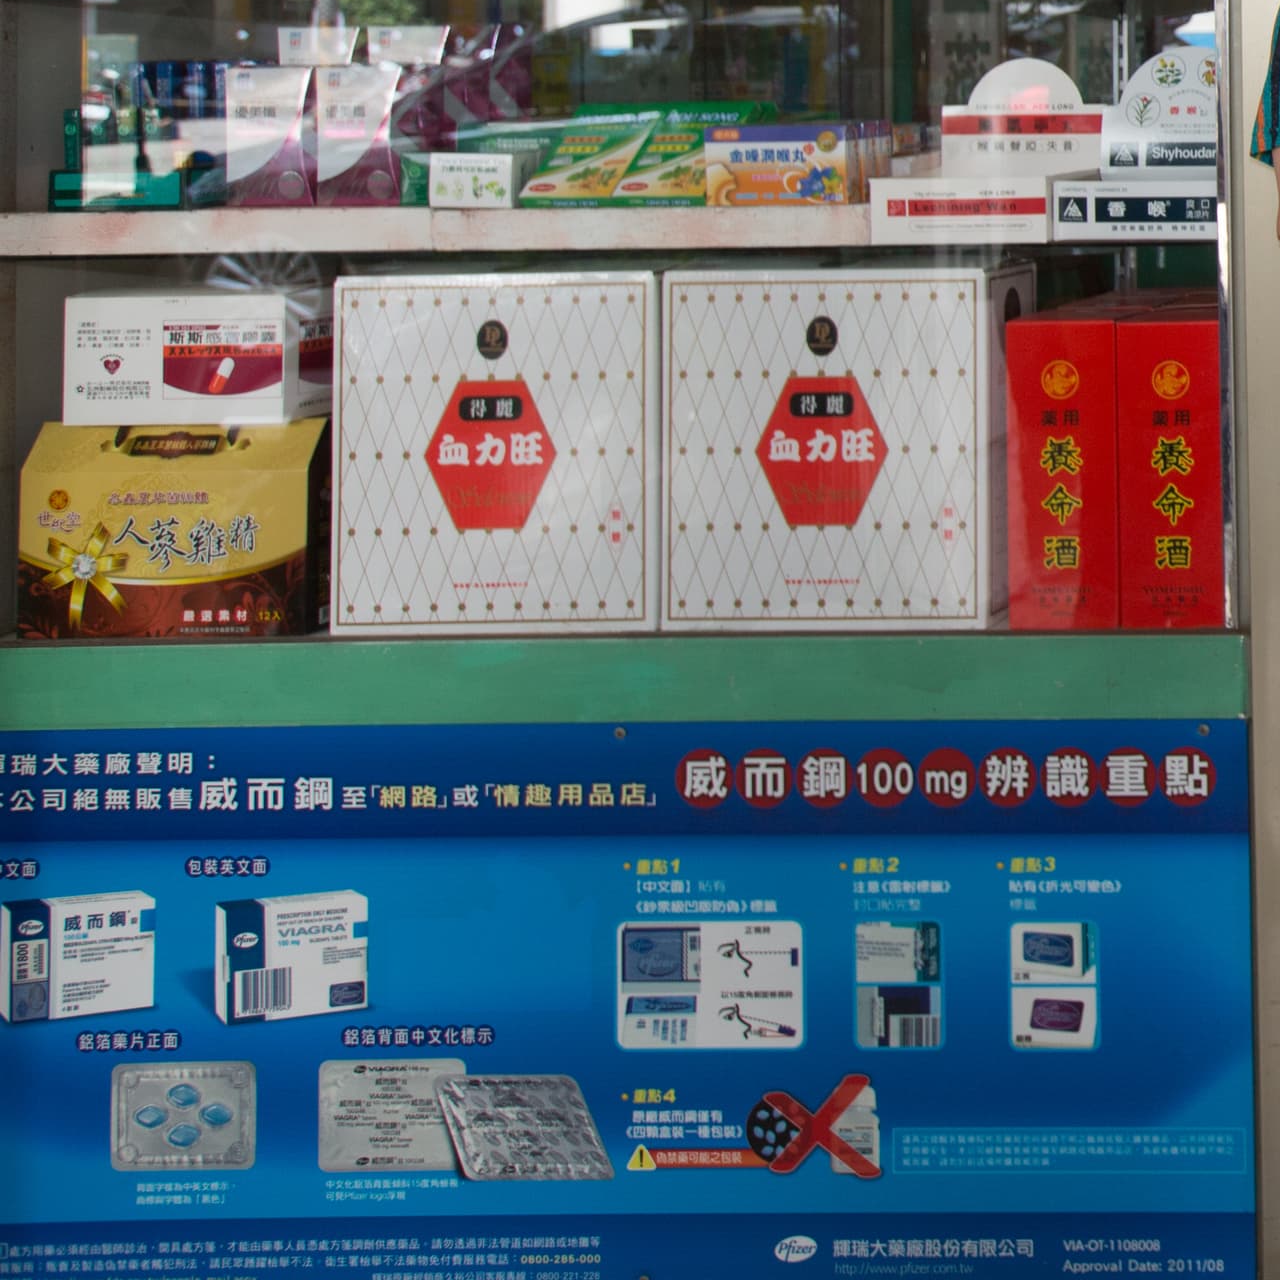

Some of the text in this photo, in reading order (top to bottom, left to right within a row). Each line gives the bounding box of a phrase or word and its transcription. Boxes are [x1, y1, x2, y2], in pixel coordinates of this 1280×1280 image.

[437, 432, 545, 466] 血力旺
[769, 429, 875, 463] 血力旺
[1040, 435, 1083, 571] 養命酒
[1151, 435, 1194, 571] 養命酒
[113, 513, 260, 572] 人蔘雞精
[183, 609, 248, 622] 嚴選素材
[0, 751, 216, 777] 瑞大藥廠聲明：
[683, 754, 1209, 801] 威而鋼 100 mg 辨識重點
[0, 776, 658, 813] 公司絕無販售威而鋼至「網路」或「情趣用品店」
[187, 858, 268, 876] 包裝英文面
[636, 858, 681, 875] 重點1
[853, 857, 900, 873] 重點2
[1010, 857, 1057, 873] 重點3
[19, 922, 43, 933] Pfizer
[64, 910, 128, 931] 威而鋼
[278, 922, 347, 937] VIAGRA
[233, 933, 258, 946] Pfizer
[79, 1033, 180, 1050] 鋁箔藥片正面
[343, 1028, 494, 1046] 鋁箔背面中文化標示
[633, 1088, 677, 1104] 重點4
[776, 1239, 817, 1260] Pfizer
[833, 1238, 1035, 1259] 輝瑞大藥廠股份有限公司
[1062, 1239, 1161, 1253] VIA-OT-1108008
[1062, 1259, 1225, 1276] Approval Date: 2011/08
